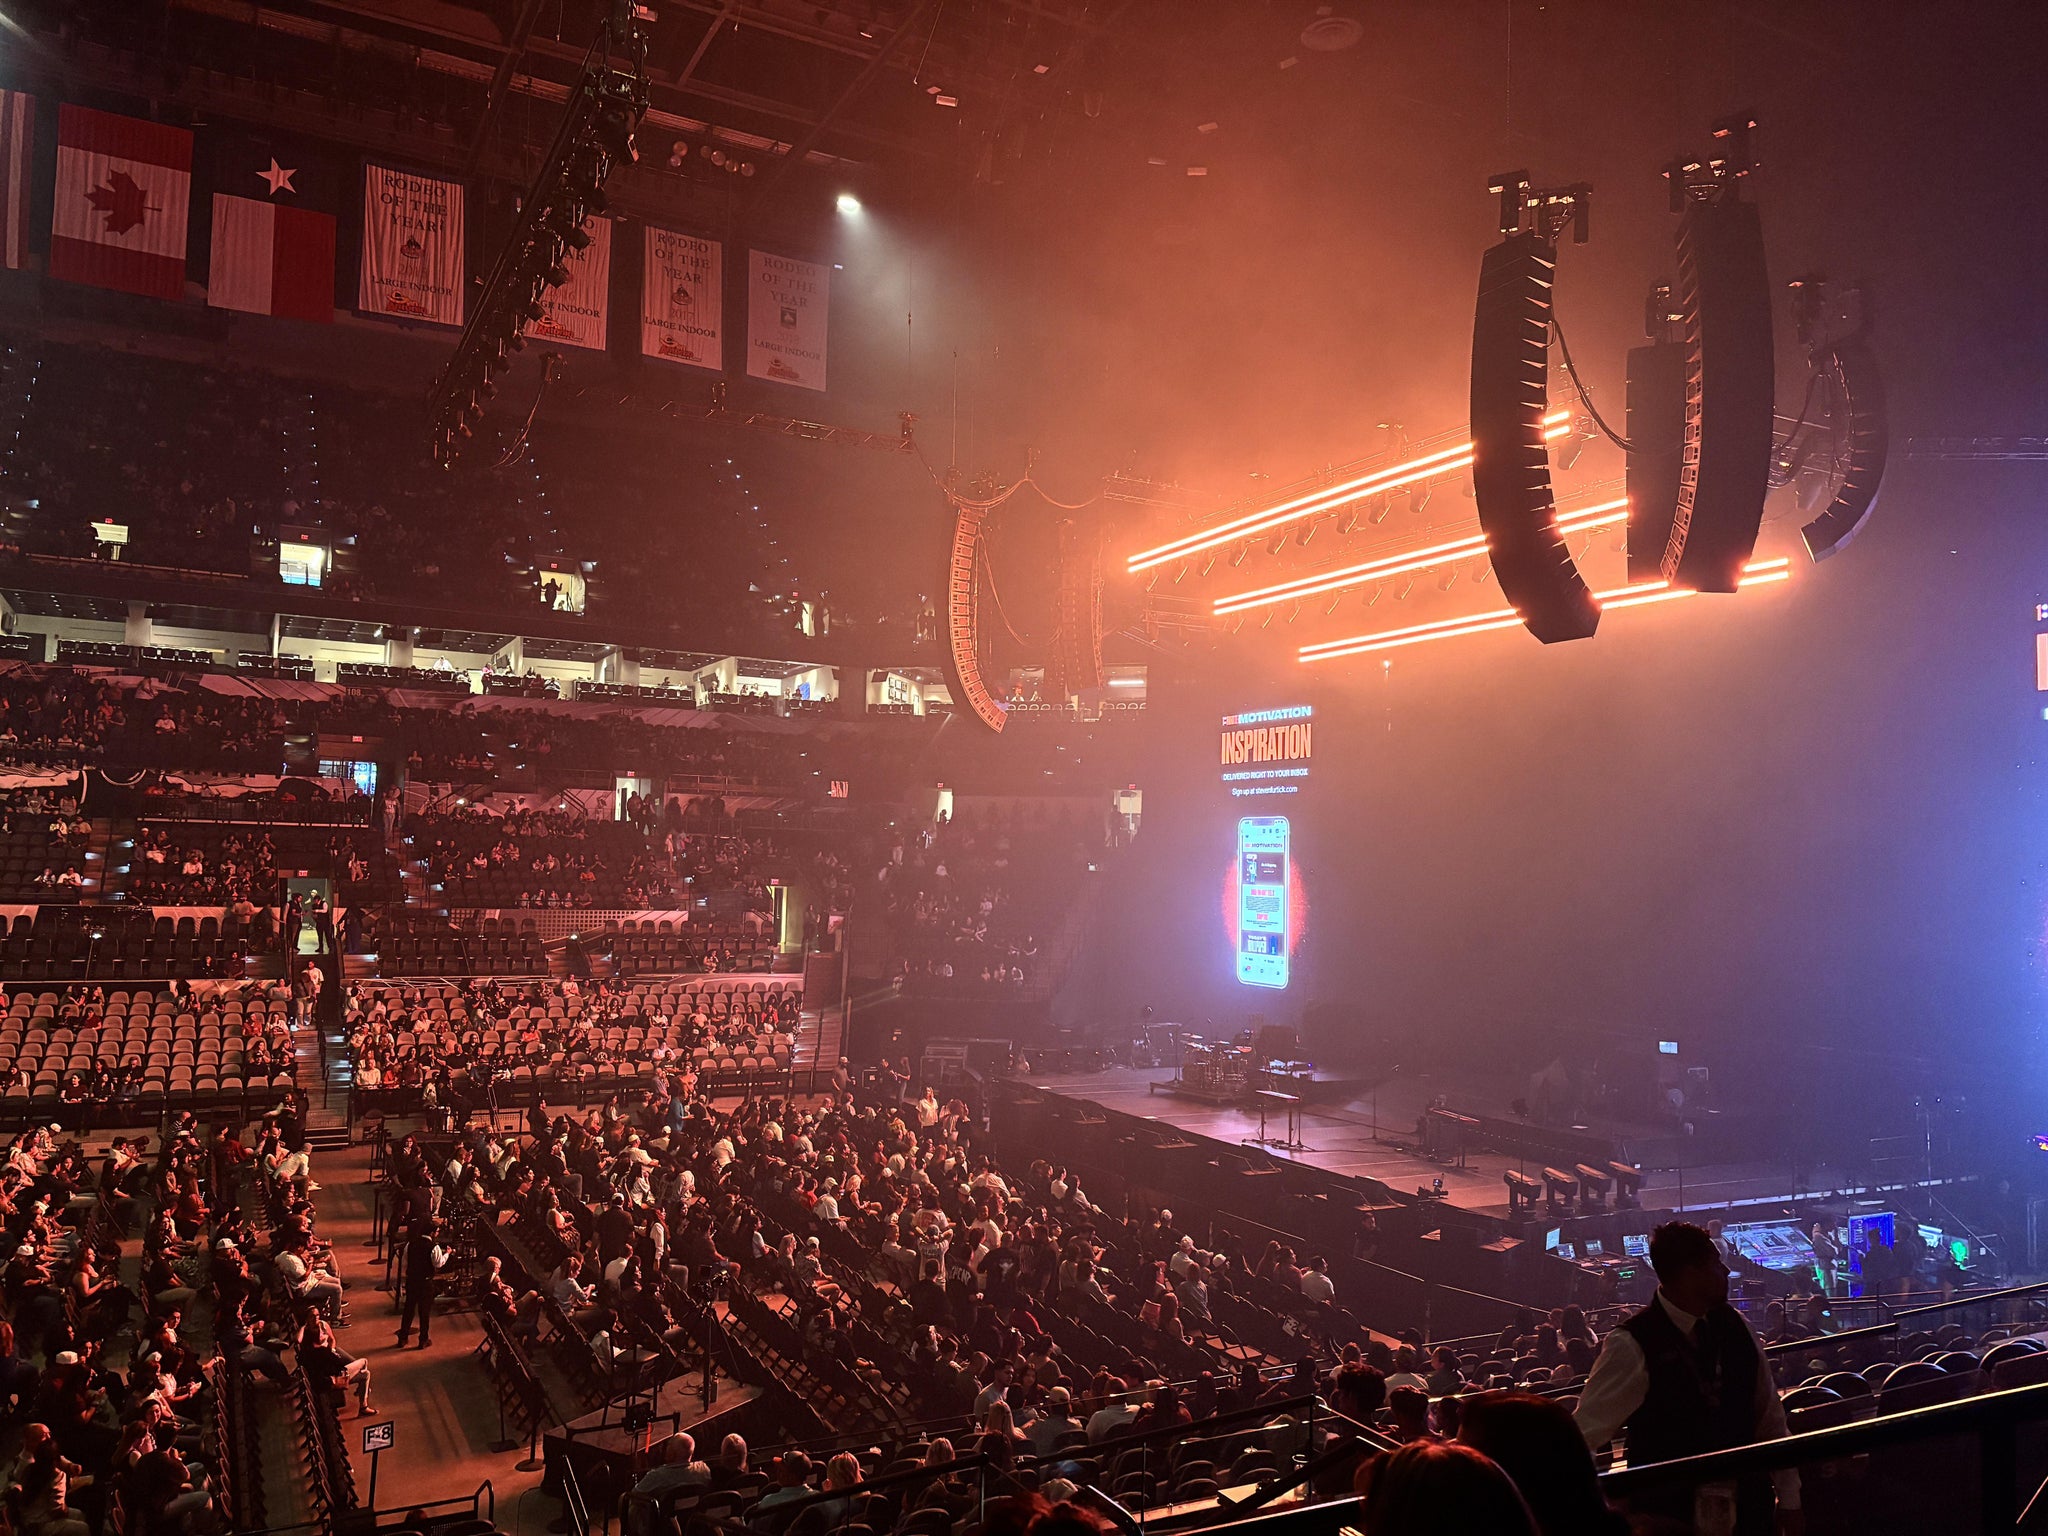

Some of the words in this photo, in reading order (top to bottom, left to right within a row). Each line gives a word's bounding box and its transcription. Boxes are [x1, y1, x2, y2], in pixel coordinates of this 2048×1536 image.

[384, 175, 446, 198] RODEO
[381, 192, 403, 207] OF
[410, 199, 448, 217] THE
[658, 233, 708, 253] RODEO
[655, 248, 674, 261] OF
[679, 254, 711, 270] THE
[764, 257, 816, 277] RODEO
[664, 266, 702, 284] YEAR
[762, 272, 781, 285] OF
[786, 278, 817, 294] THE
[371, 275, 407, 289] LARGE
[409, 282, 453, 297] INDOOR
[771, 290, 808, 307] YEAR
[558, 303, 601, 318] INDOOR
[645, 317, 676, 330] LARGE
[678, 324, 717, 338] INDOOR
[754, 339, 783, 353] LARGE
[785, 346, 821, 361] INDOOR
[347, 688, 362, 697] 108
[1239, 706, 1312, 724] MOTIVATION
[1221, 723, 1312, 765] INSPIRATION
[1250, 770, 1267, 780] RIGHT
[1267, 770, 1275, 778] TO
[1275, 769, 1290, 778] YOUR
[1243, 788, 1250, 796] up
[367, 1426, 391, 1444] F-8
